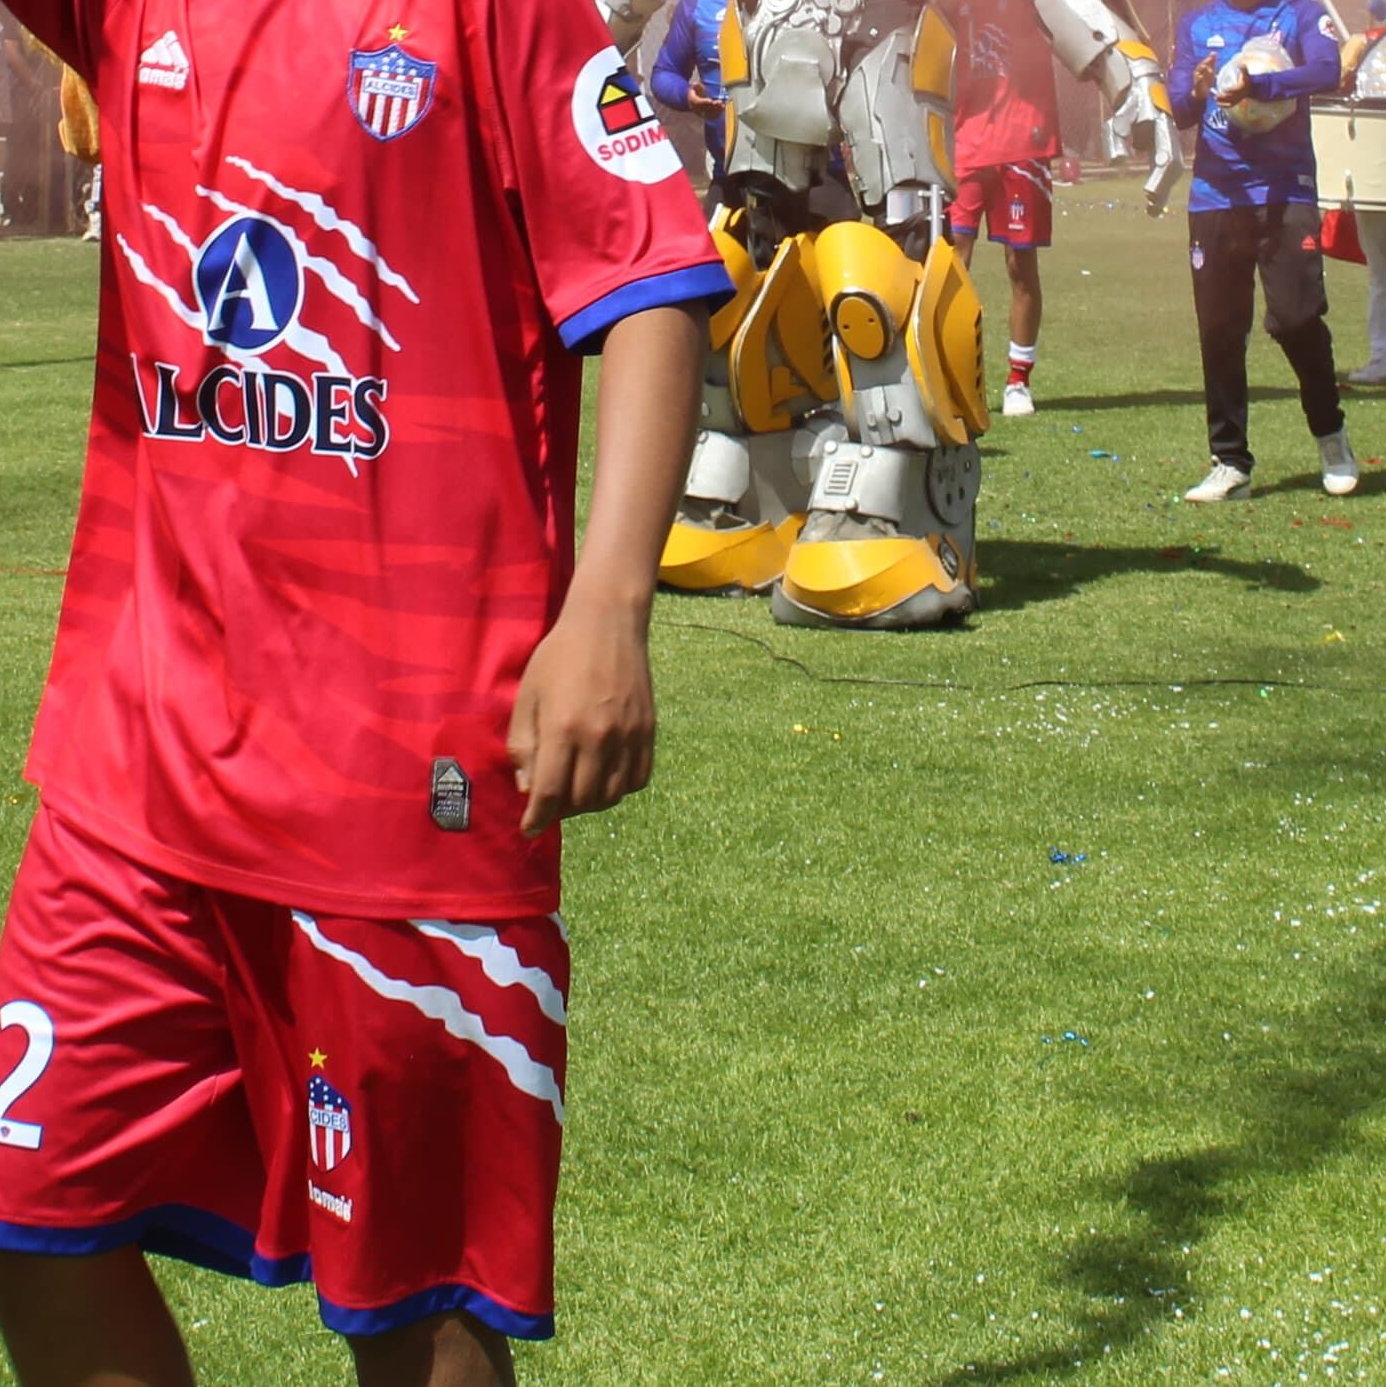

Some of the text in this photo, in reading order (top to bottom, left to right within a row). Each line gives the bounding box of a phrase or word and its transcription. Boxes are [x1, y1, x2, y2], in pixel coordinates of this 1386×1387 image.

[366, 80, 415, 96] ALCIDES
[597, 125, 669, 162] SODIM
[207, 231, 280, 332] A
[310, 1108, 348, 1130] CIDES
